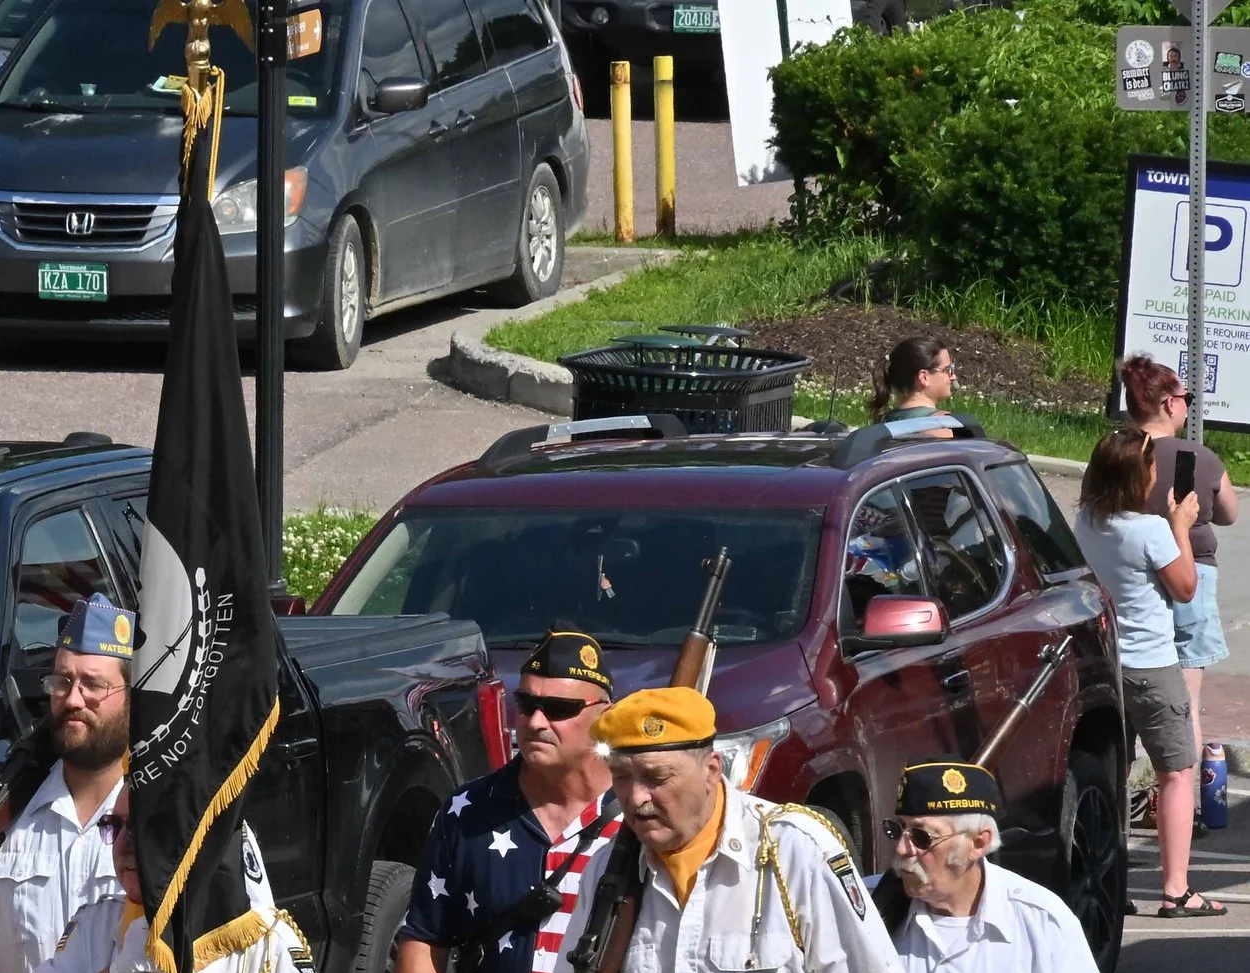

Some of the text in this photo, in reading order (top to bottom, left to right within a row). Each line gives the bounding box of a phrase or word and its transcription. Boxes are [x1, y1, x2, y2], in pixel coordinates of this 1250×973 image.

[678, 12, 711, 26] 20418
[1122, 67, 1149, 79] summer
[1125, 79, 1132, 90] is
[44, 272, 100, 291] KZA 170
[1204, 288, 1236, 302] PAID
[1145, 300, 1189, 315] PUBLI
[1148, 321, 1183, 333] LICENSE
[1153, 333, 1177, 344] SCAN
[1221, 341, 1233, 351] TO
[161, 727, 193, 768] NOT
[191, 592, 234, 727] FORGOTTEN
